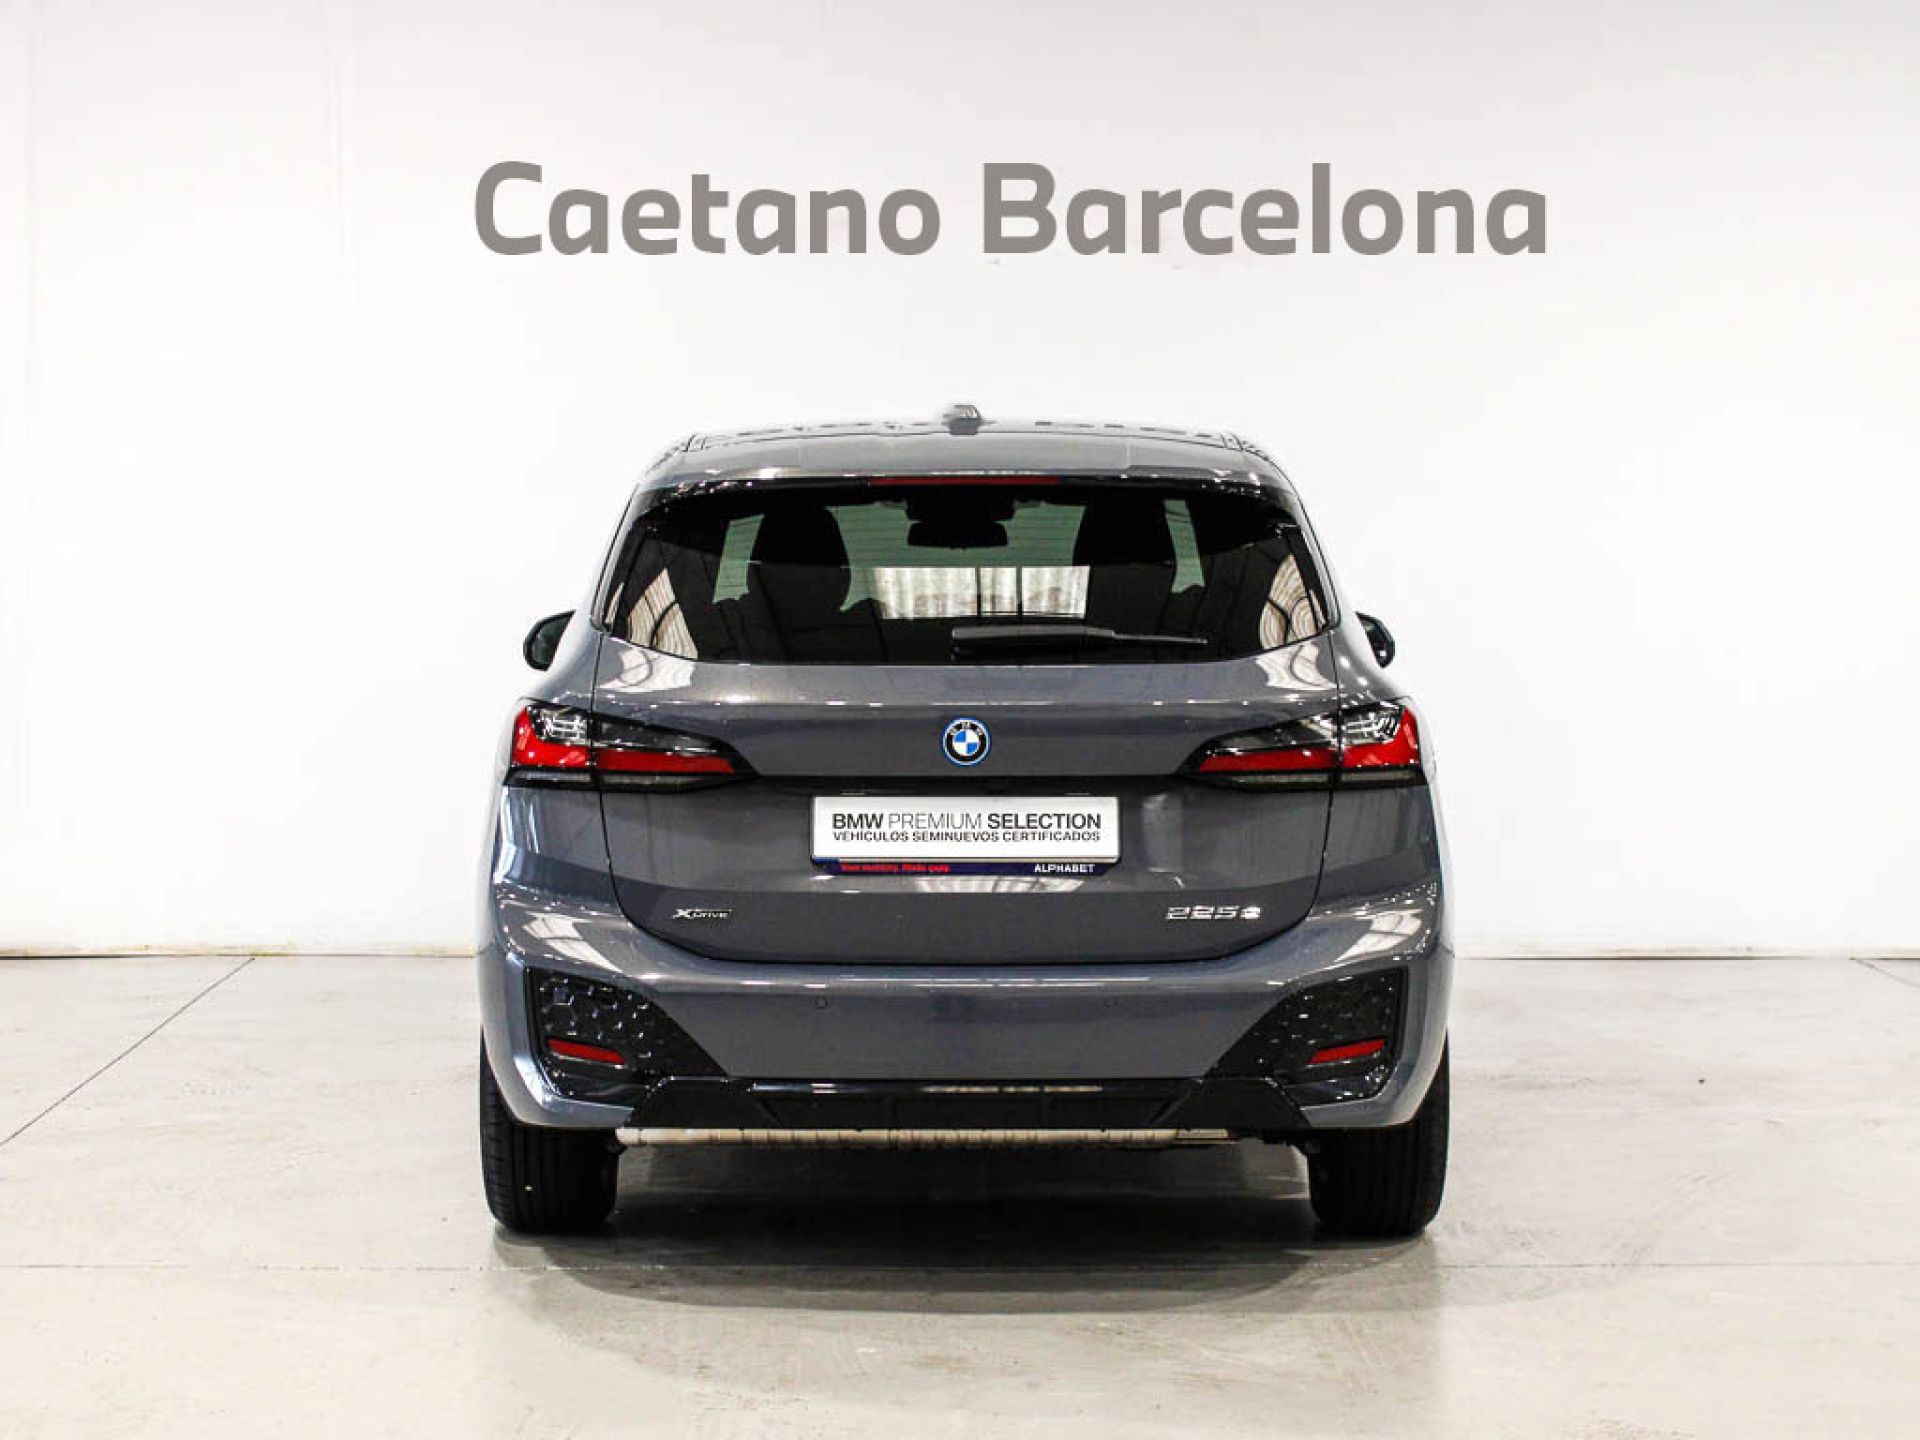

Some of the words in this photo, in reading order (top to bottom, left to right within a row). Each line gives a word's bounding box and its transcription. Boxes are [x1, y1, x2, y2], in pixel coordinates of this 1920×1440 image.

[474, 160, 940, 256] Caetano
[982, 161, 1548, 256] Barcelona
[832, 813, 884, 830] BMW
[888, 813, 982, 830] PREMIUM
[987, 813, 1102, 830] SELECTION
[912, 830, 1000, 842] SEMINUEVOS
[1002, 830, 1101, 842] CERTIFICADOS
[1033, 863, 1096, 873] ALPHABET
